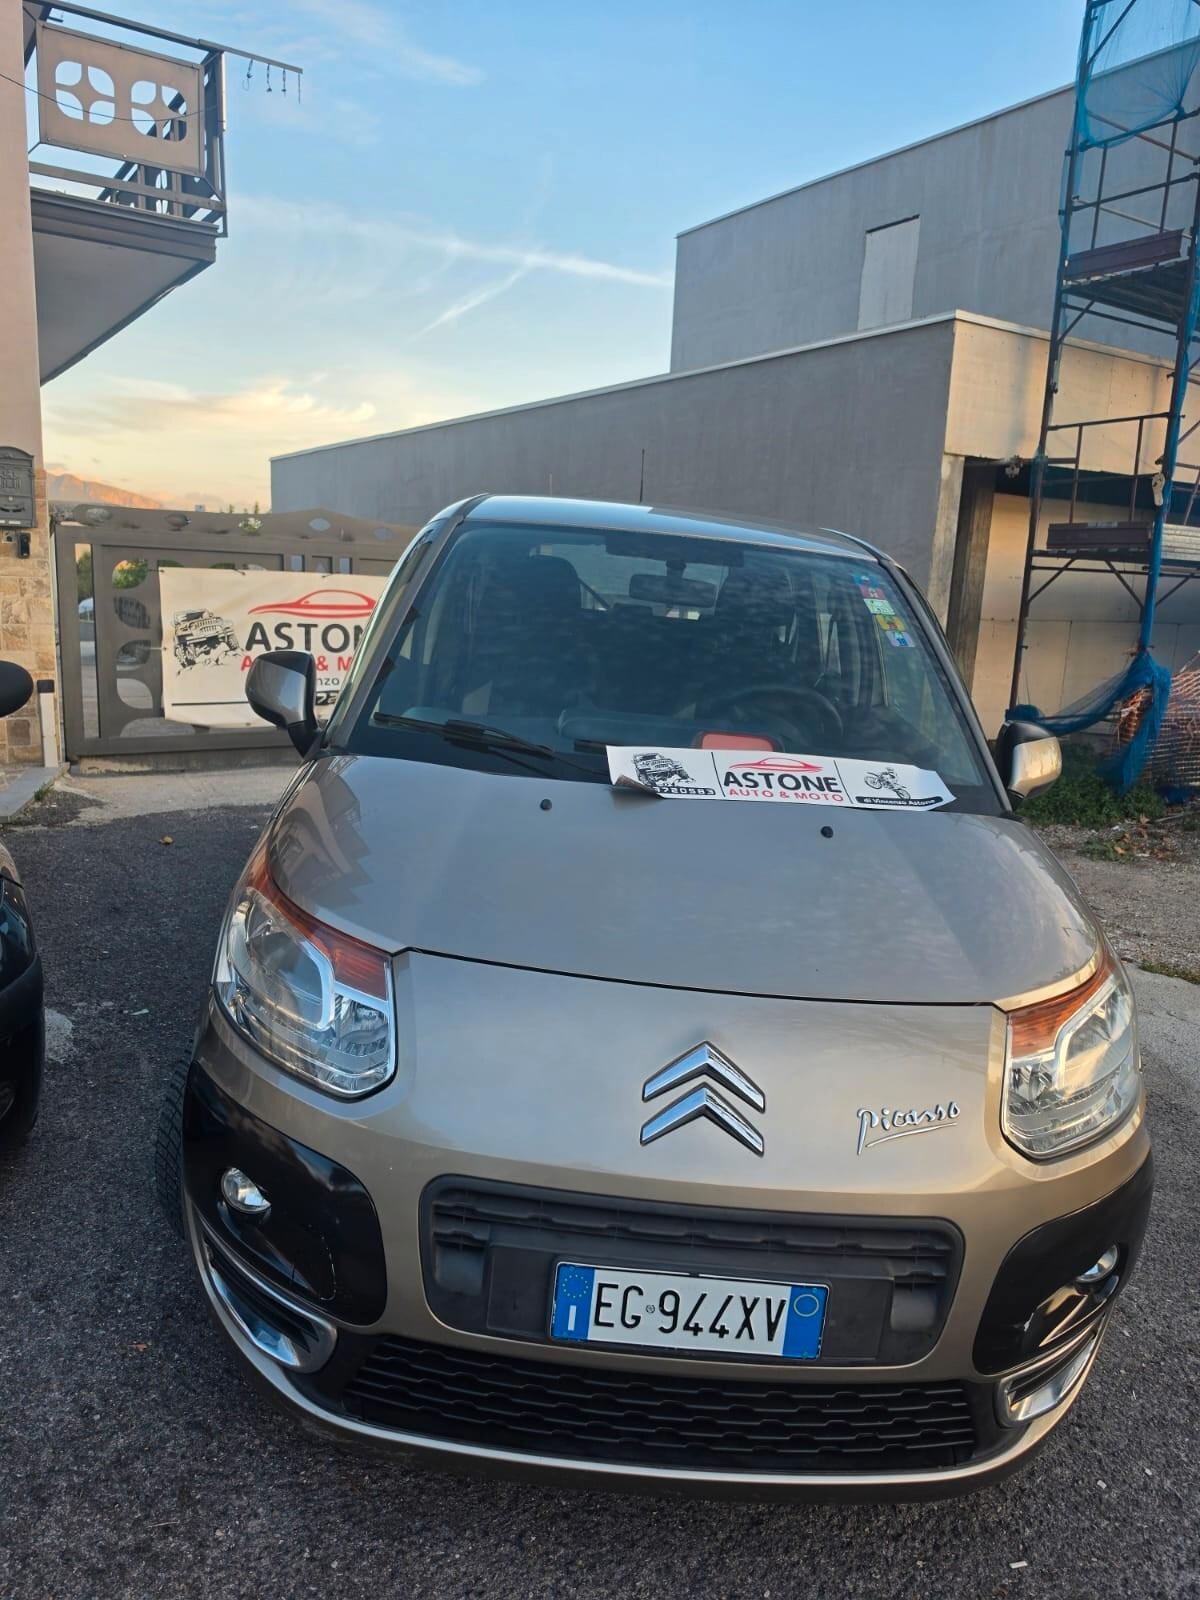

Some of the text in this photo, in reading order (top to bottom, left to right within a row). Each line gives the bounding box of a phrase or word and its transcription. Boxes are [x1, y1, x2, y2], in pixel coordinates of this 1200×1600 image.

[723, 771, 842, 793] ASTONE
[729, 788, 844, 802] AUTO & MOTO
[593, 1283, 644, 1329] EG
[657, 1289, 787, 1342] 944XV
